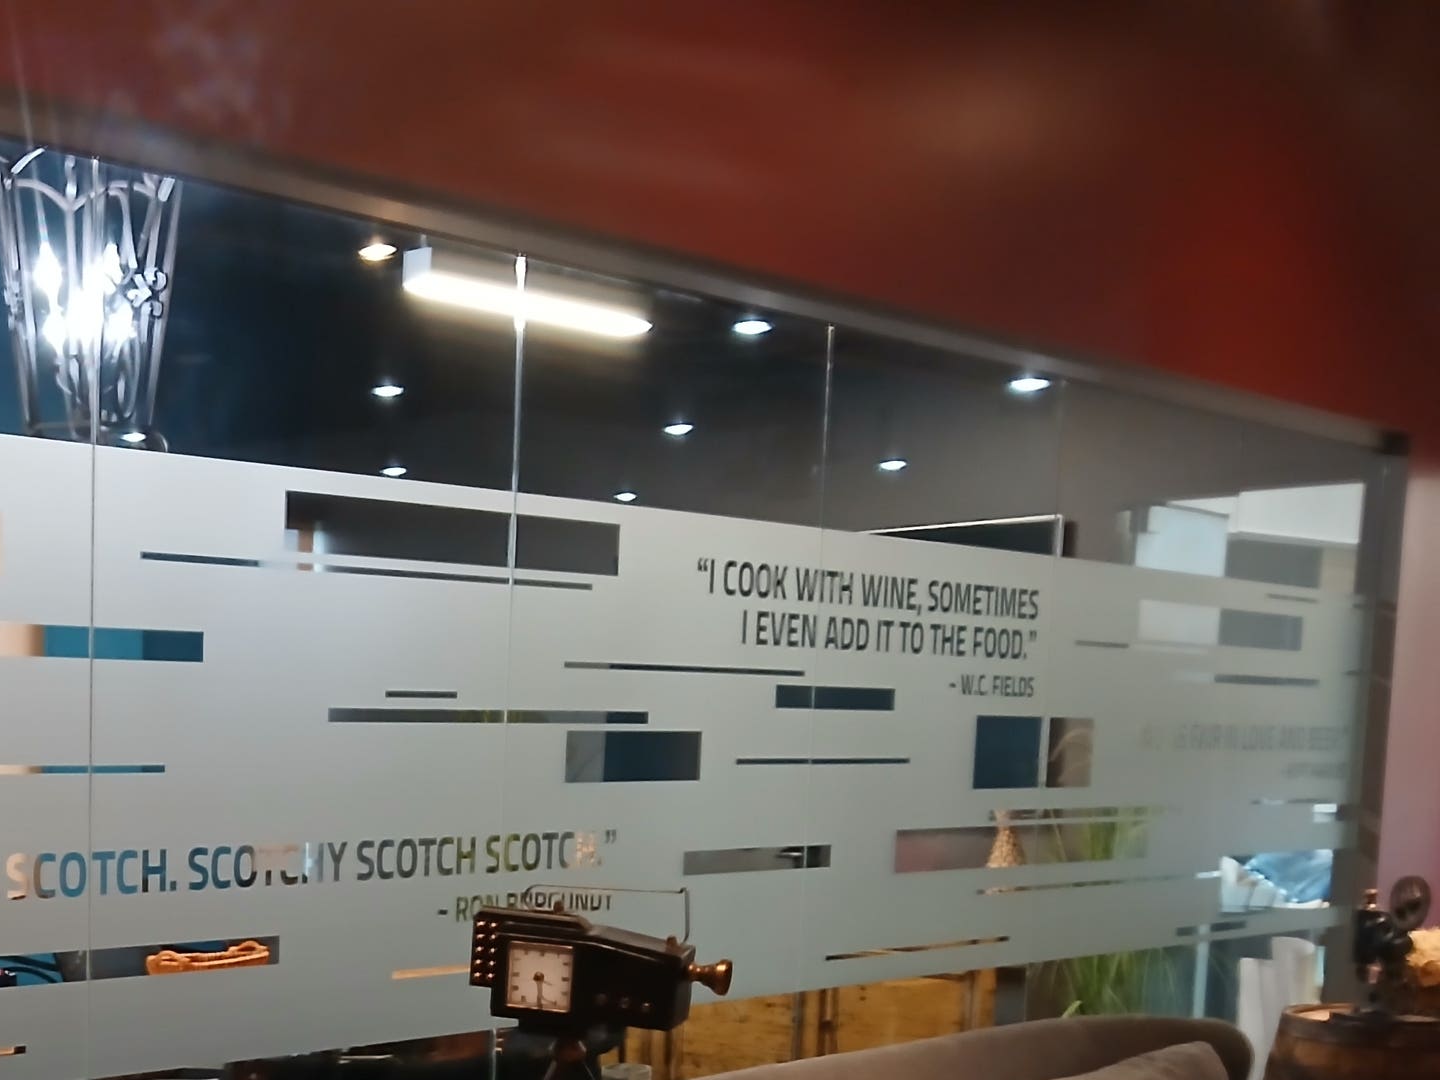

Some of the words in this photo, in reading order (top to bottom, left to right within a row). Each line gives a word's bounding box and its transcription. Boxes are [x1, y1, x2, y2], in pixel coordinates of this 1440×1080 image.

[724, 560, 788, 601] COOK
[796, 566, 853, 606] WITH
[861, 573, 922, 616] WINE,
[927, 579, 1039, 621] SOMETIMES
[741, 609, 748, 645] I
[756, 611, 817, 649] EVEN
[825, 616, 869, 652] ADD
[876, 619, 894, 654] IT
[899, 621, 924, 655] TO
[930, 623, 966, 657] THE
[993, 674, 1035, 699] FIELDS
[6, 848, 178, 900] SCOTCH.
[188, 841, 348, 891] SCOTCHY
[357, 836, 477, 881] SCOTCH
